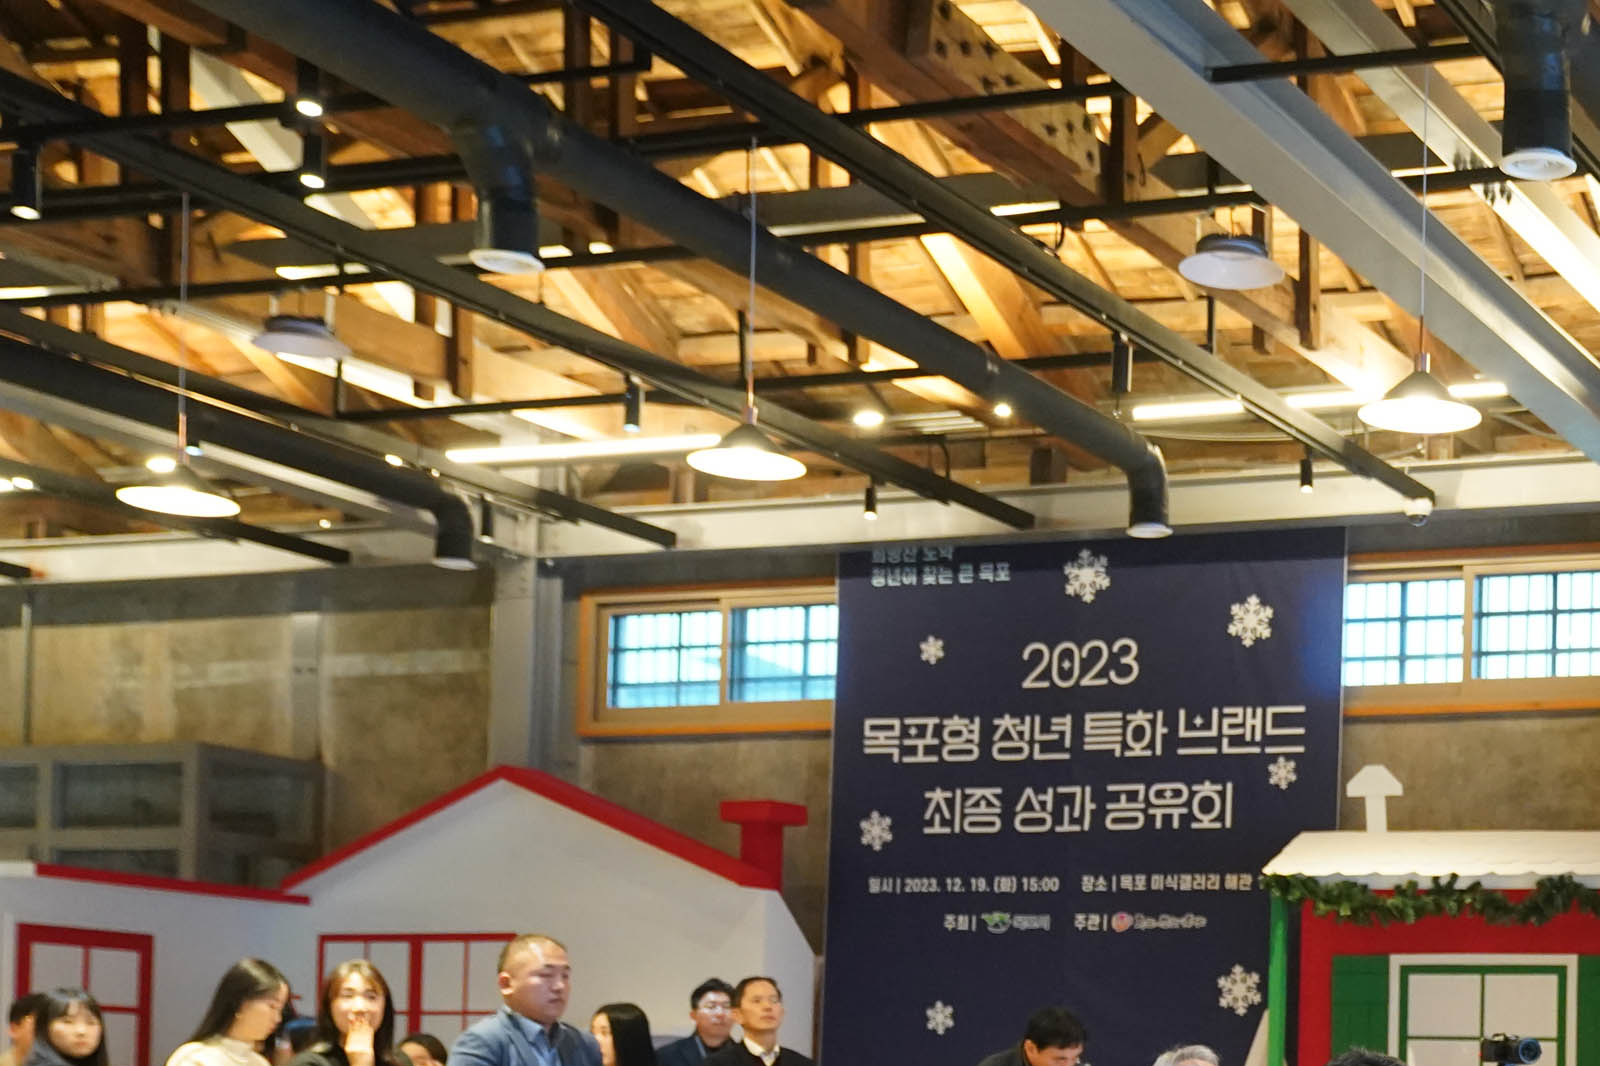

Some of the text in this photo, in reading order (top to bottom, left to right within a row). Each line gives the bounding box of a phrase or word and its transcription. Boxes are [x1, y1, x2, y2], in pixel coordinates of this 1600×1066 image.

[979, 562, 1011, 583] 목포
[1022, 638, 1139, 688] 2023
[864, 705, 1306, 763] 목포형 청년 특화 브랜드
[924, 781, 1232, 833] 최종 성과 공유회
[869, 878, 893, 893] 일시
[904, 878, 940, 892] 2023.
[946, 877, 964, 892] 12.
[971, 877, 990, 892] 19.
[1022, 877, 1059, 892] 15:00
[1082, 875, 1107, 892] 장소
[1120, 874, 1146, 891] 목포
[944, 914, 969, 931] 주최
[1074, 913, 1101, 930] 주관
